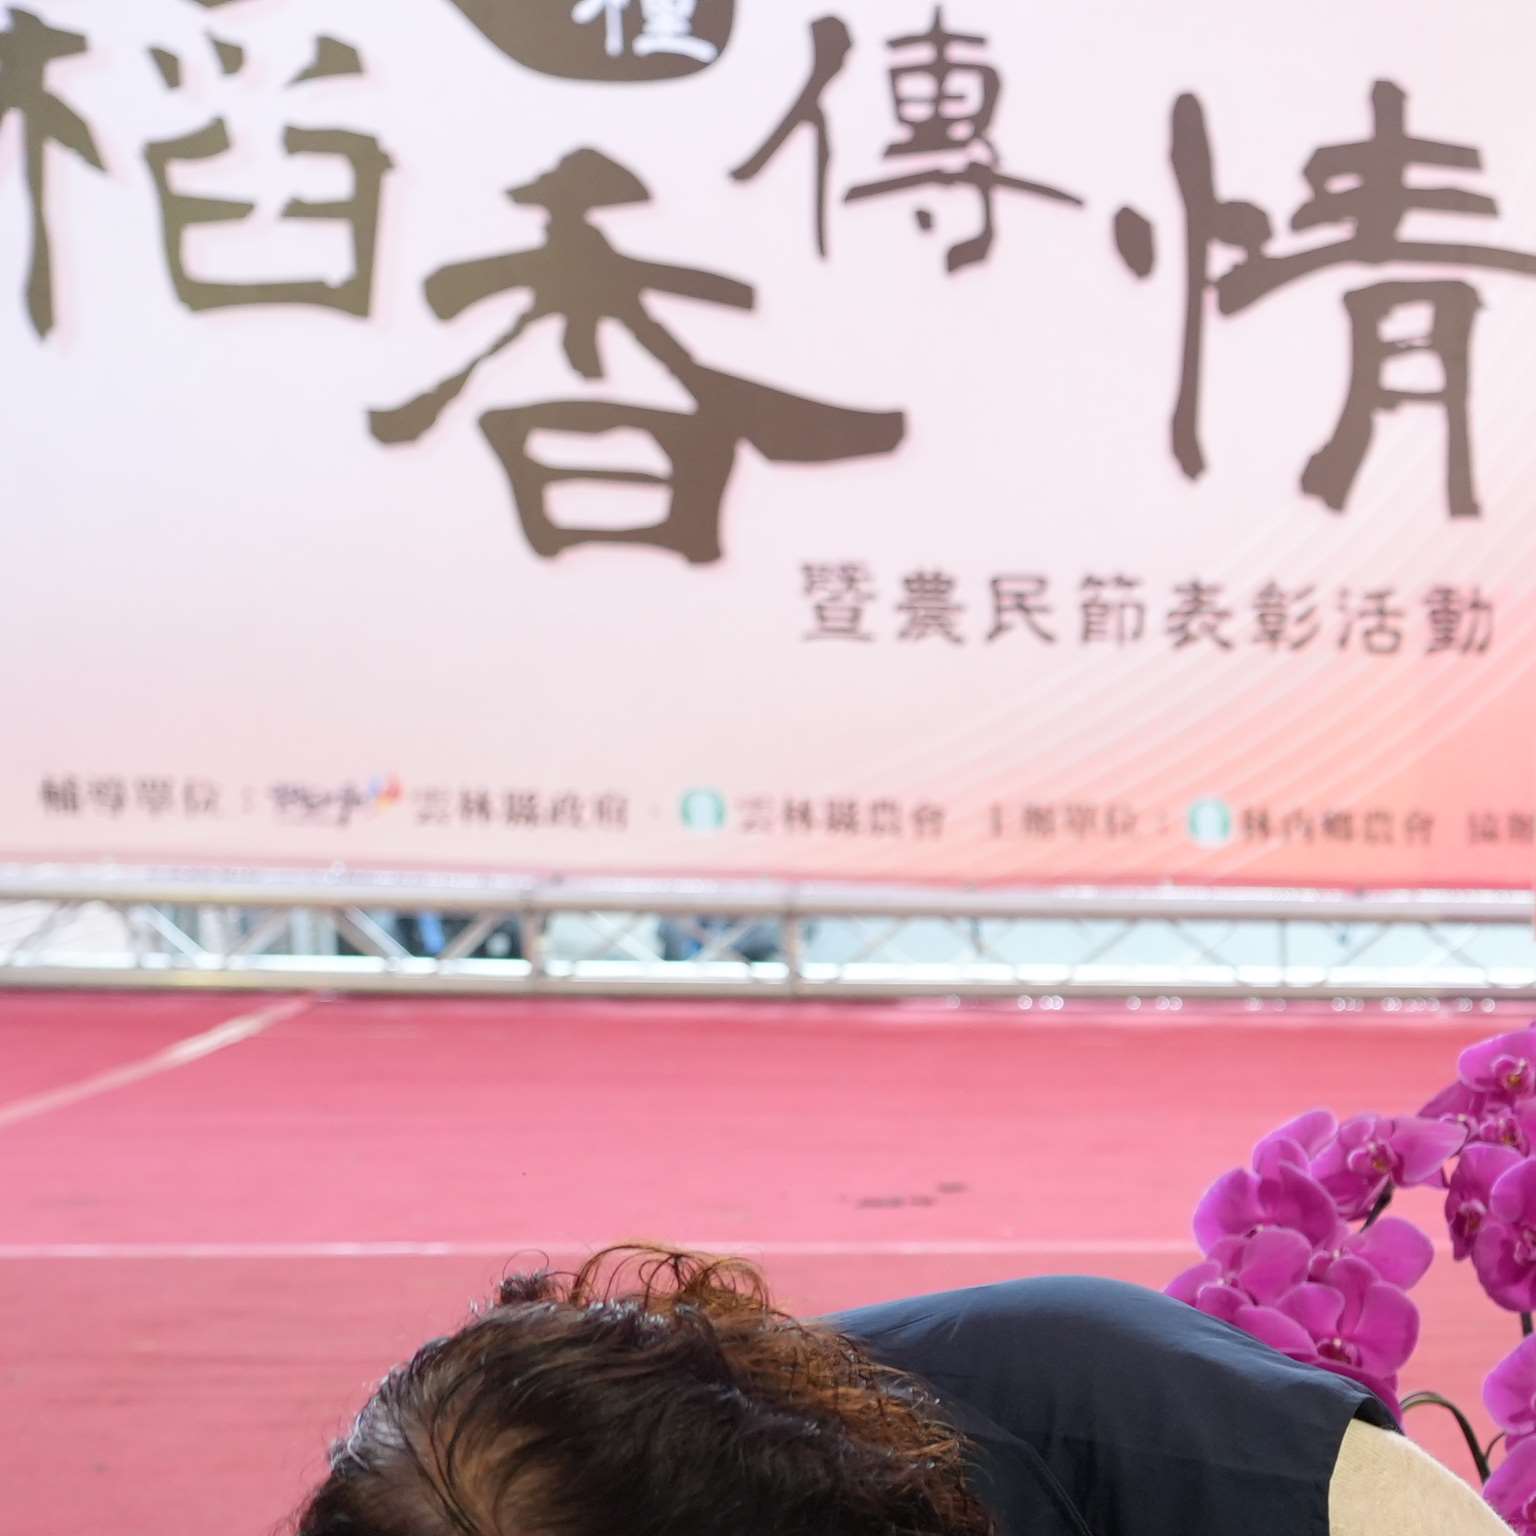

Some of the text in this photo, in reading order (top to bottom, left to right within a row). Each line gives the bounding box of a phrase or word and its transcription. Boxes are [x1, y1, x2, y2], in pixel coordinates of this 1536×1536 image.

[802, 562, 1494, 656] 暨農民節表彰活動
